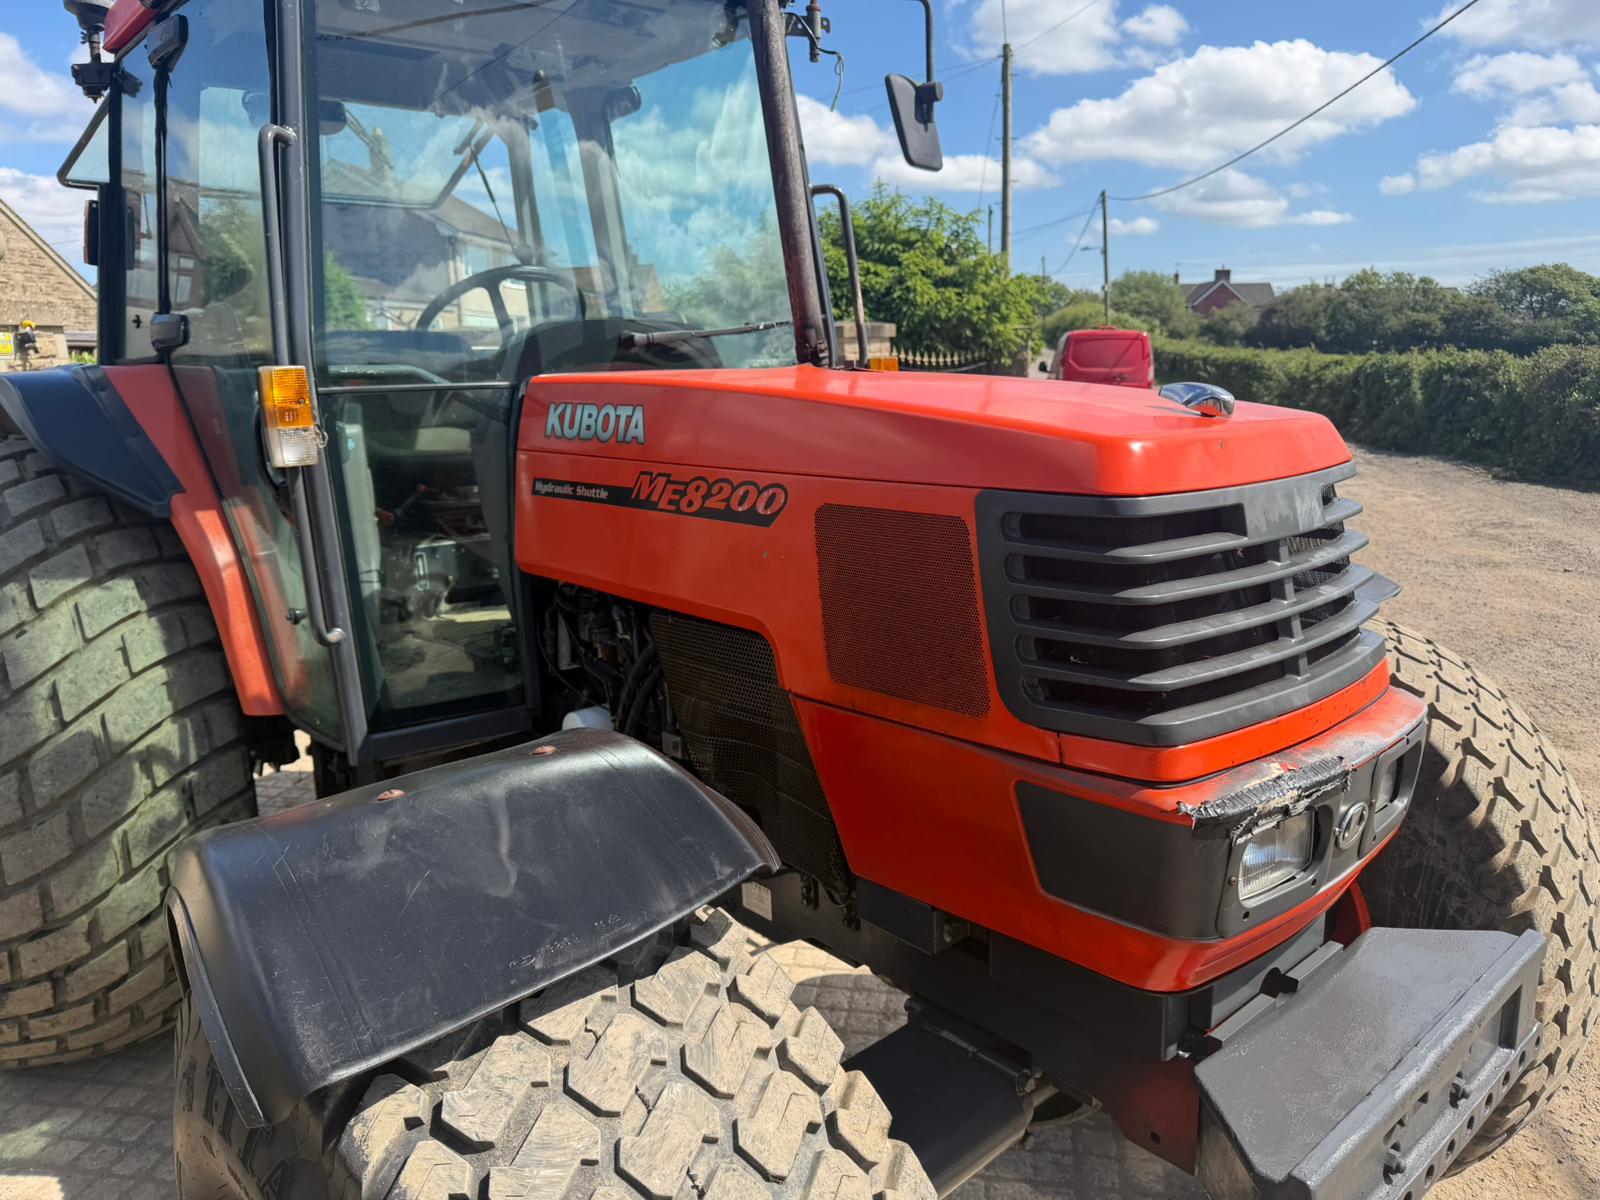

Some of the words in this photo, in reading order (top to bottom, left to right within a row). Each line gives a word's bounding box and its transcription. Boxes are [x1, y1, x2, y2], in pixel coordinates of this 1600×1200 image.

[545, 402, 645, 444] KUBOTA
[535, 480, 573, 494] Hydraulic
[576, 486, 609, 500] Shuttle
[631, 471, 787, 516] ME8200
